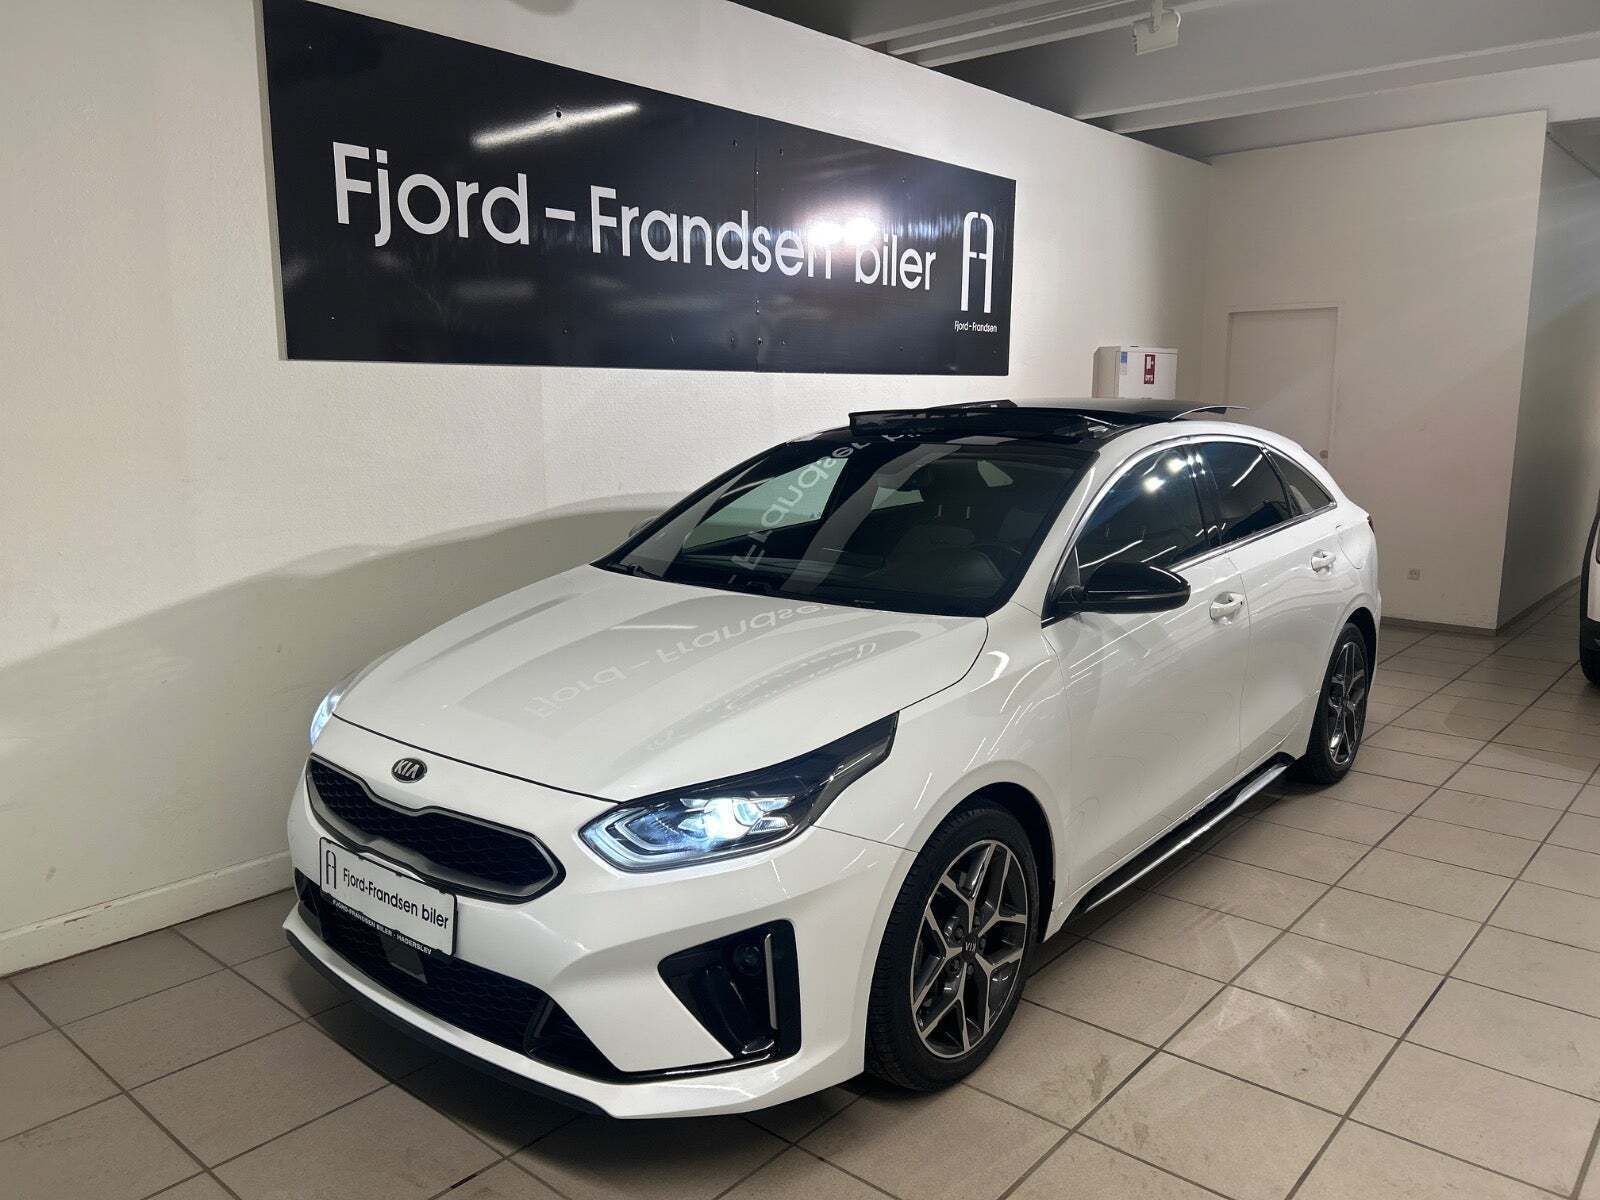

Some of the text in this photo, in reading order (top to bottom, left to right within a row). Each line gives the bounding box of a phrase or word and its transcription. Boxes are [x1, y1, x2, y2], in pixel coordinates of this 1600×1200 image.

[333, 141, 529, 247] Fjord
[855, 230, 938, 291] biler
[343, 867, 449, 929] Fjord-Frandsen biler
